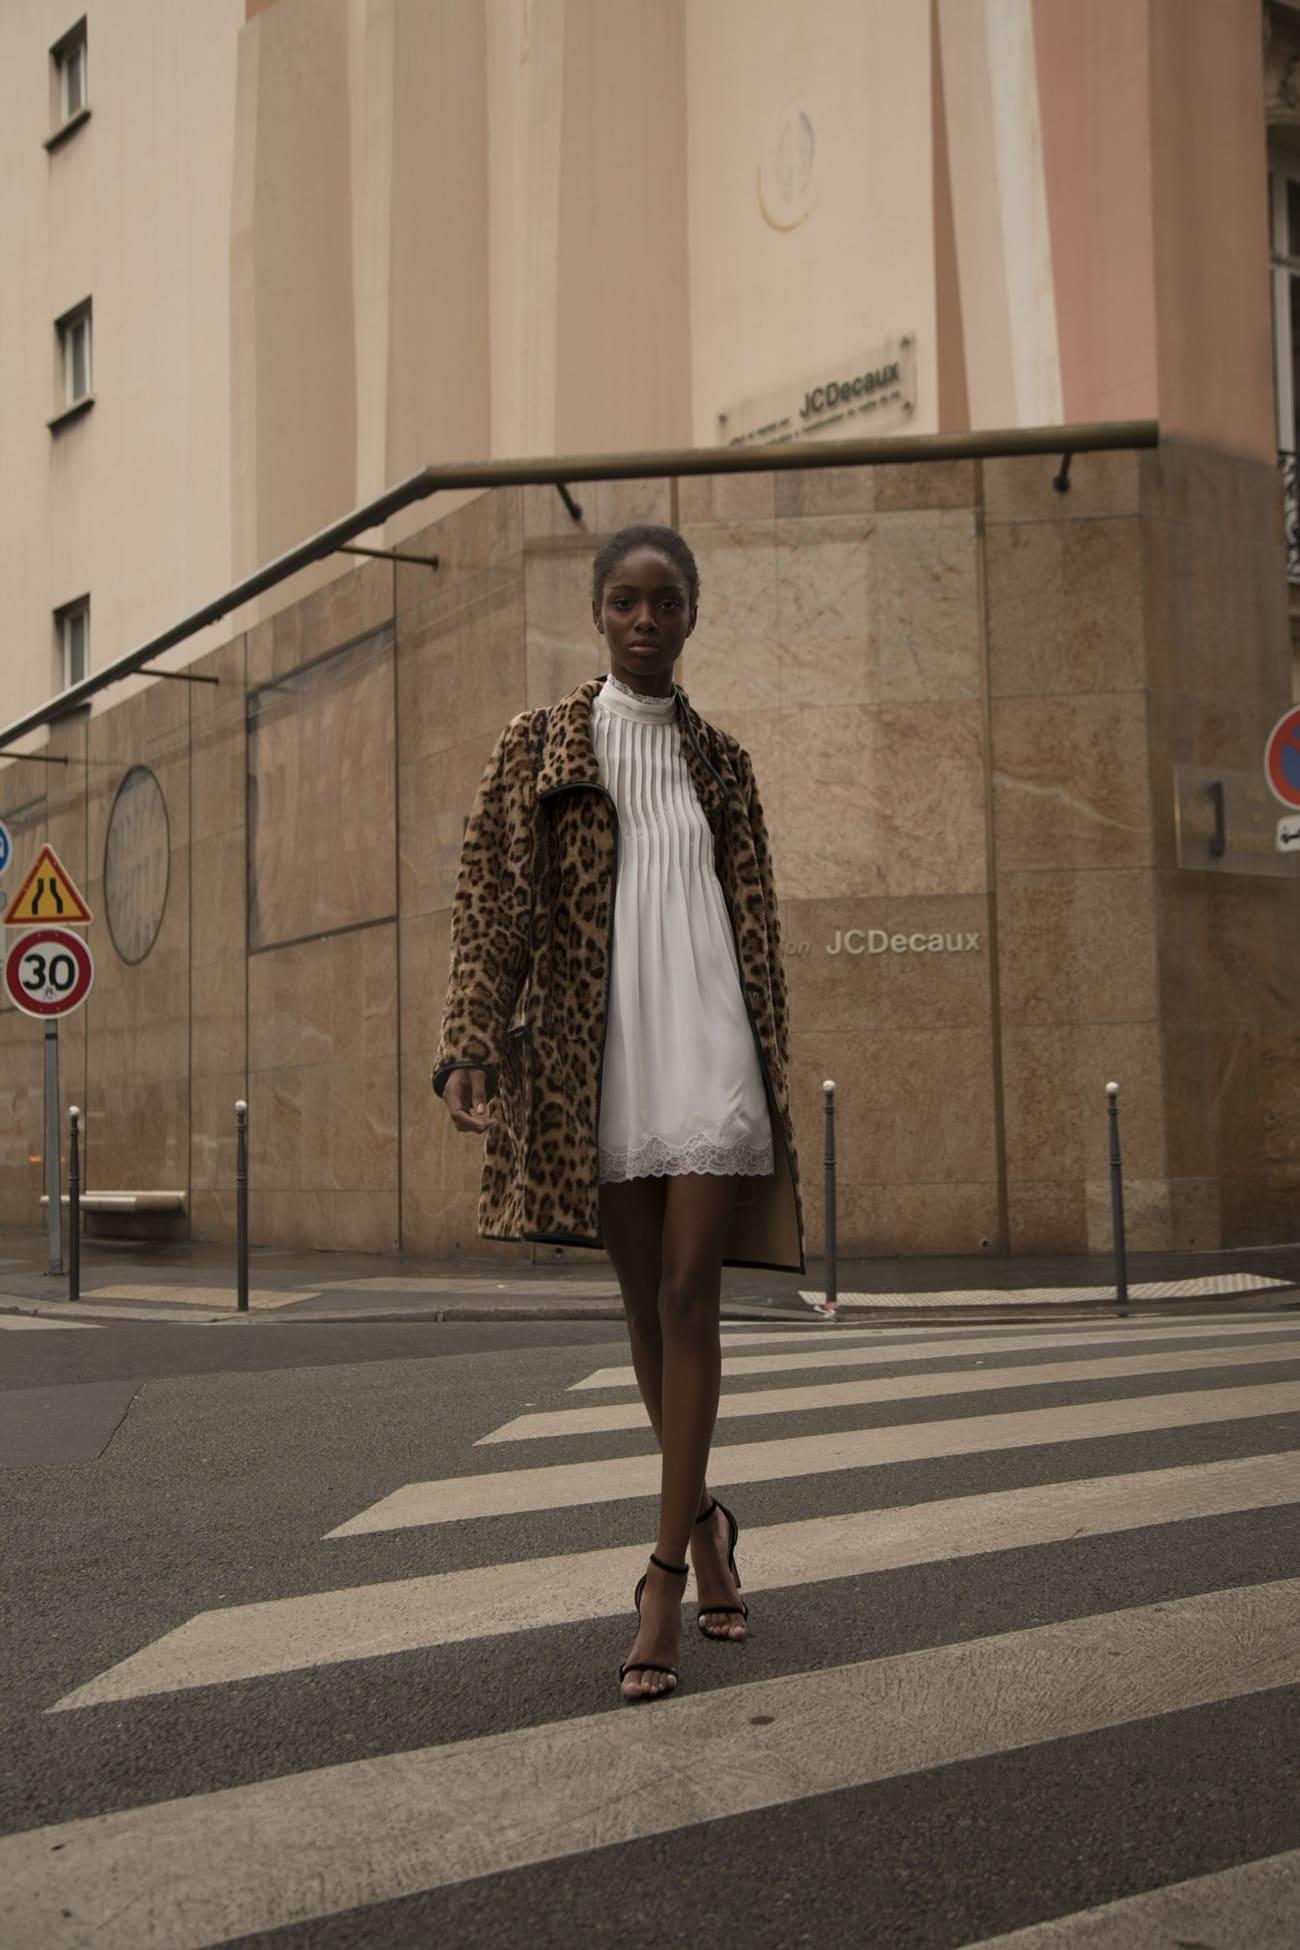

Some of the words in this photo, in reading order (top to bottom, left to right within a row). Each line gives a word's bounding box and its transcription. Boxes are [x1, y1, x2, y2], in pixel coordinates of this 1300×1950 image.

[800, 361, 899, 418] JCDecaux
[826, 928, 980, 954] JCDecaux
[23, 954, 75, 991] 30
